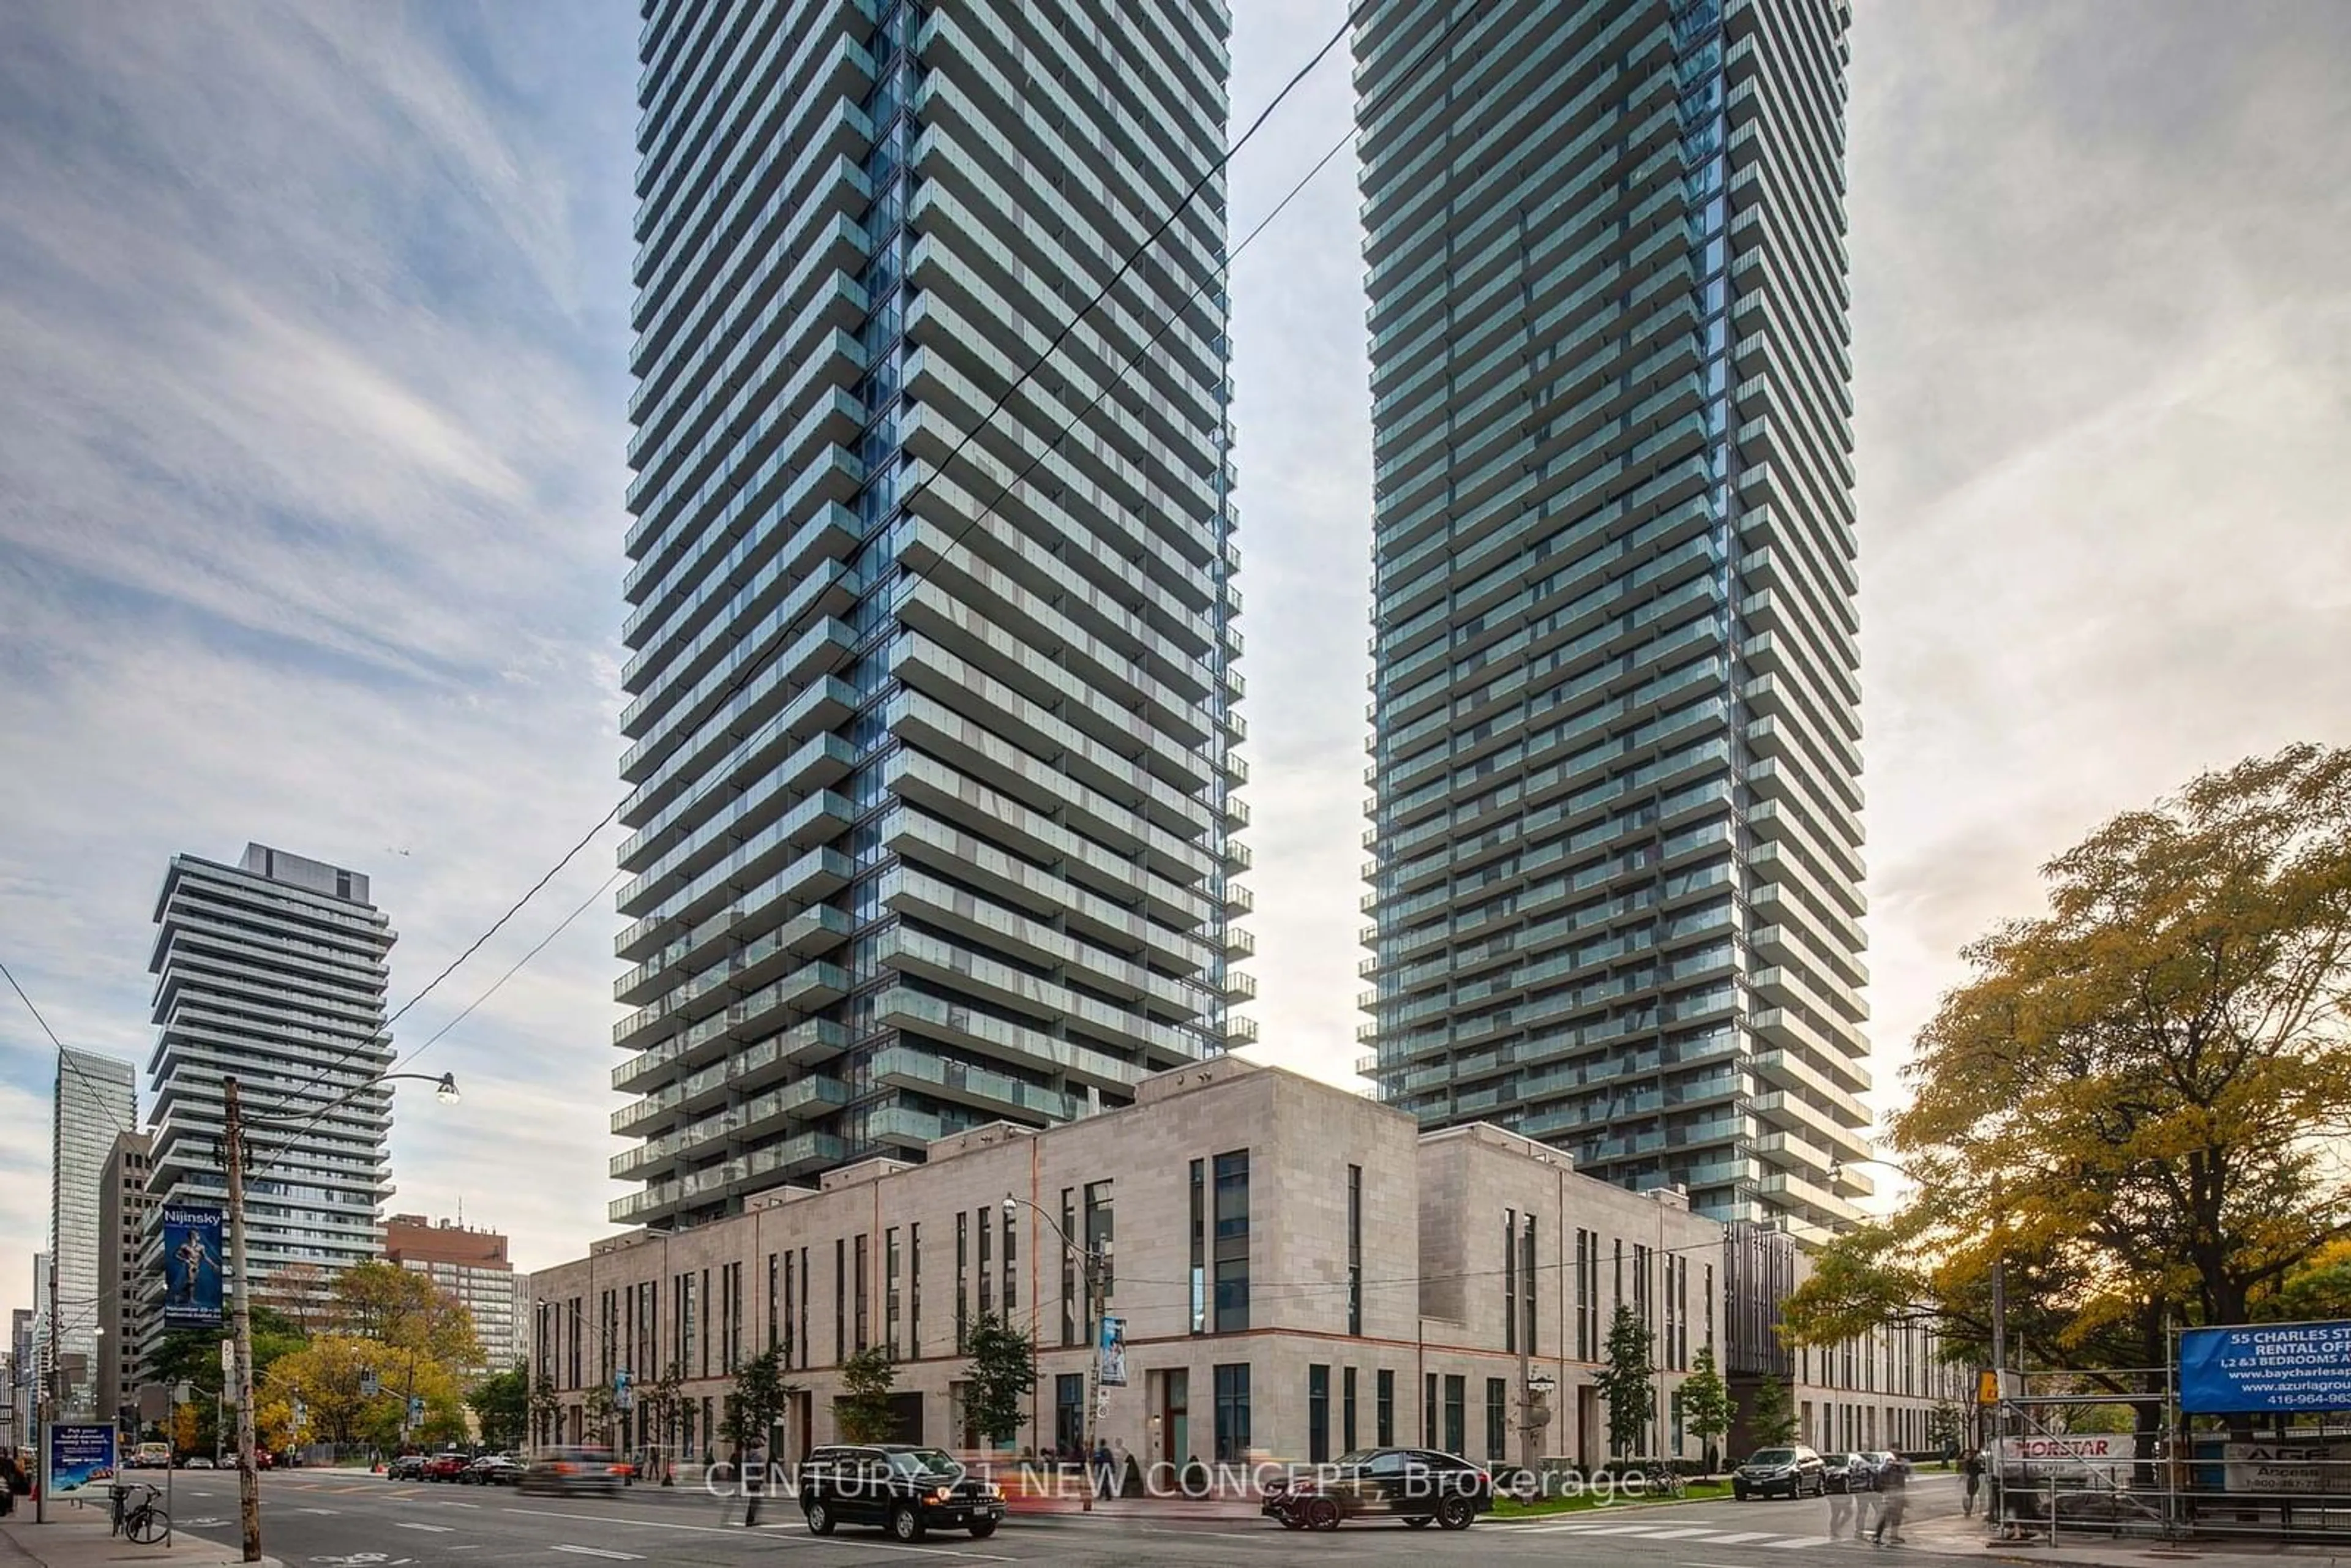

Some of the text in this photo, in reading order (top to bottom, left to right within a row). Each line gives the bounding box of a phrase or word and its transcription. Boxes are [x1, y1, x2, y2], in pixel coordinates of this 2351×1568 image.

[165, 1210, 220, 1226] Nijinsky
[2231, 1334, 2251, 1344] 55
[2254, 1330, 2328, 1343] CHARLES
[2255, 1343, 2318, 1355] RENTAL
[2259, 1354, 2338, 1366] BEDROOMS
